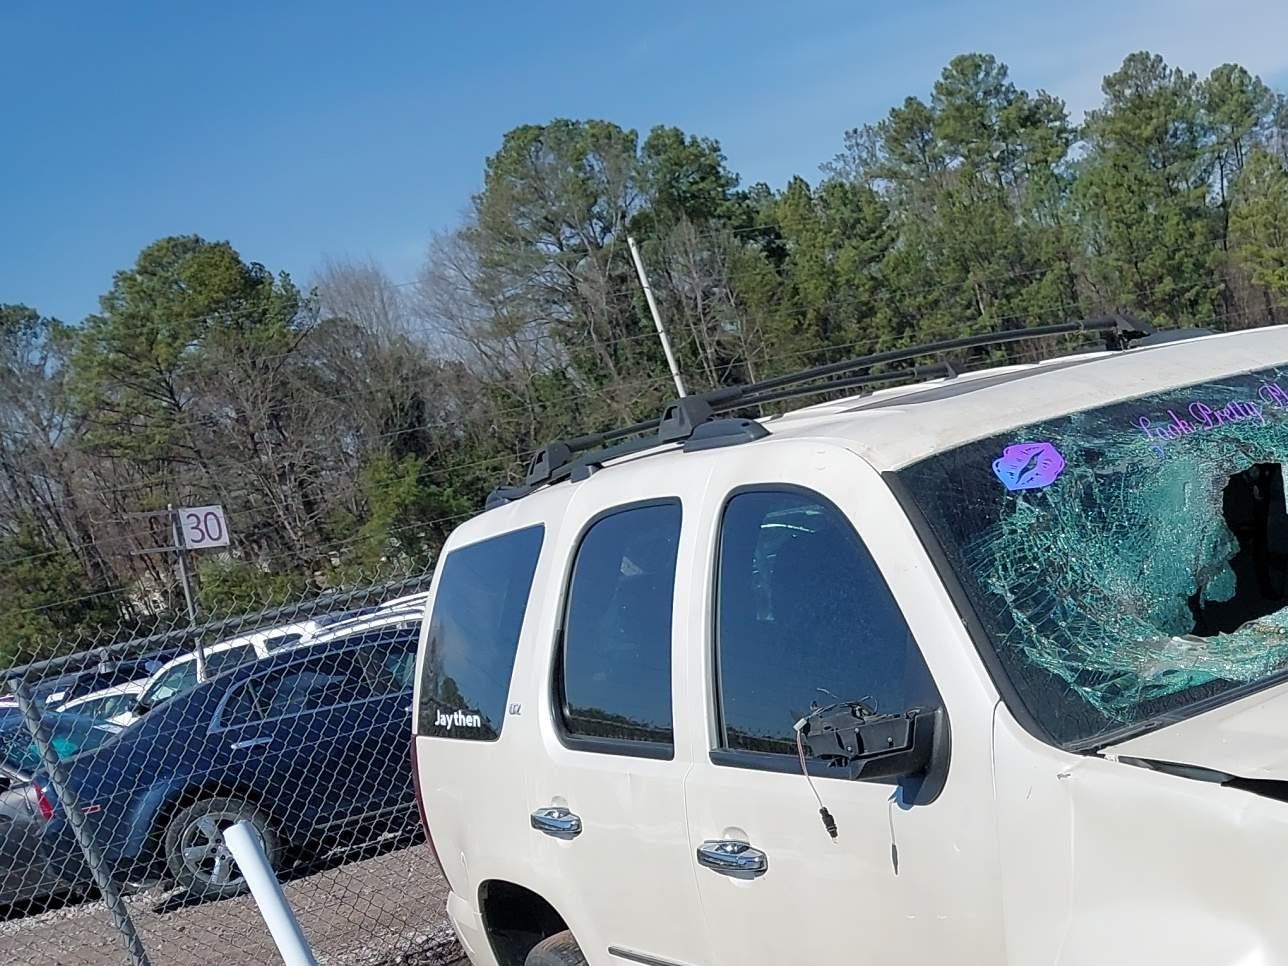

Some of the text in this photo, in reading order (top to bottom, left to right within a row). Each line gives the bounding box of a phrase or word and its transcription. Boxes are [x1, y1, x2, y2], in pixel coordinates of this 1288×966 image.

[1130, 410, 1195, 440] Look
[1189, 401, 1266, 430] Pretty
[186, 511, 223, 543] 30
[434, 709, 481, 731] Jaythen
